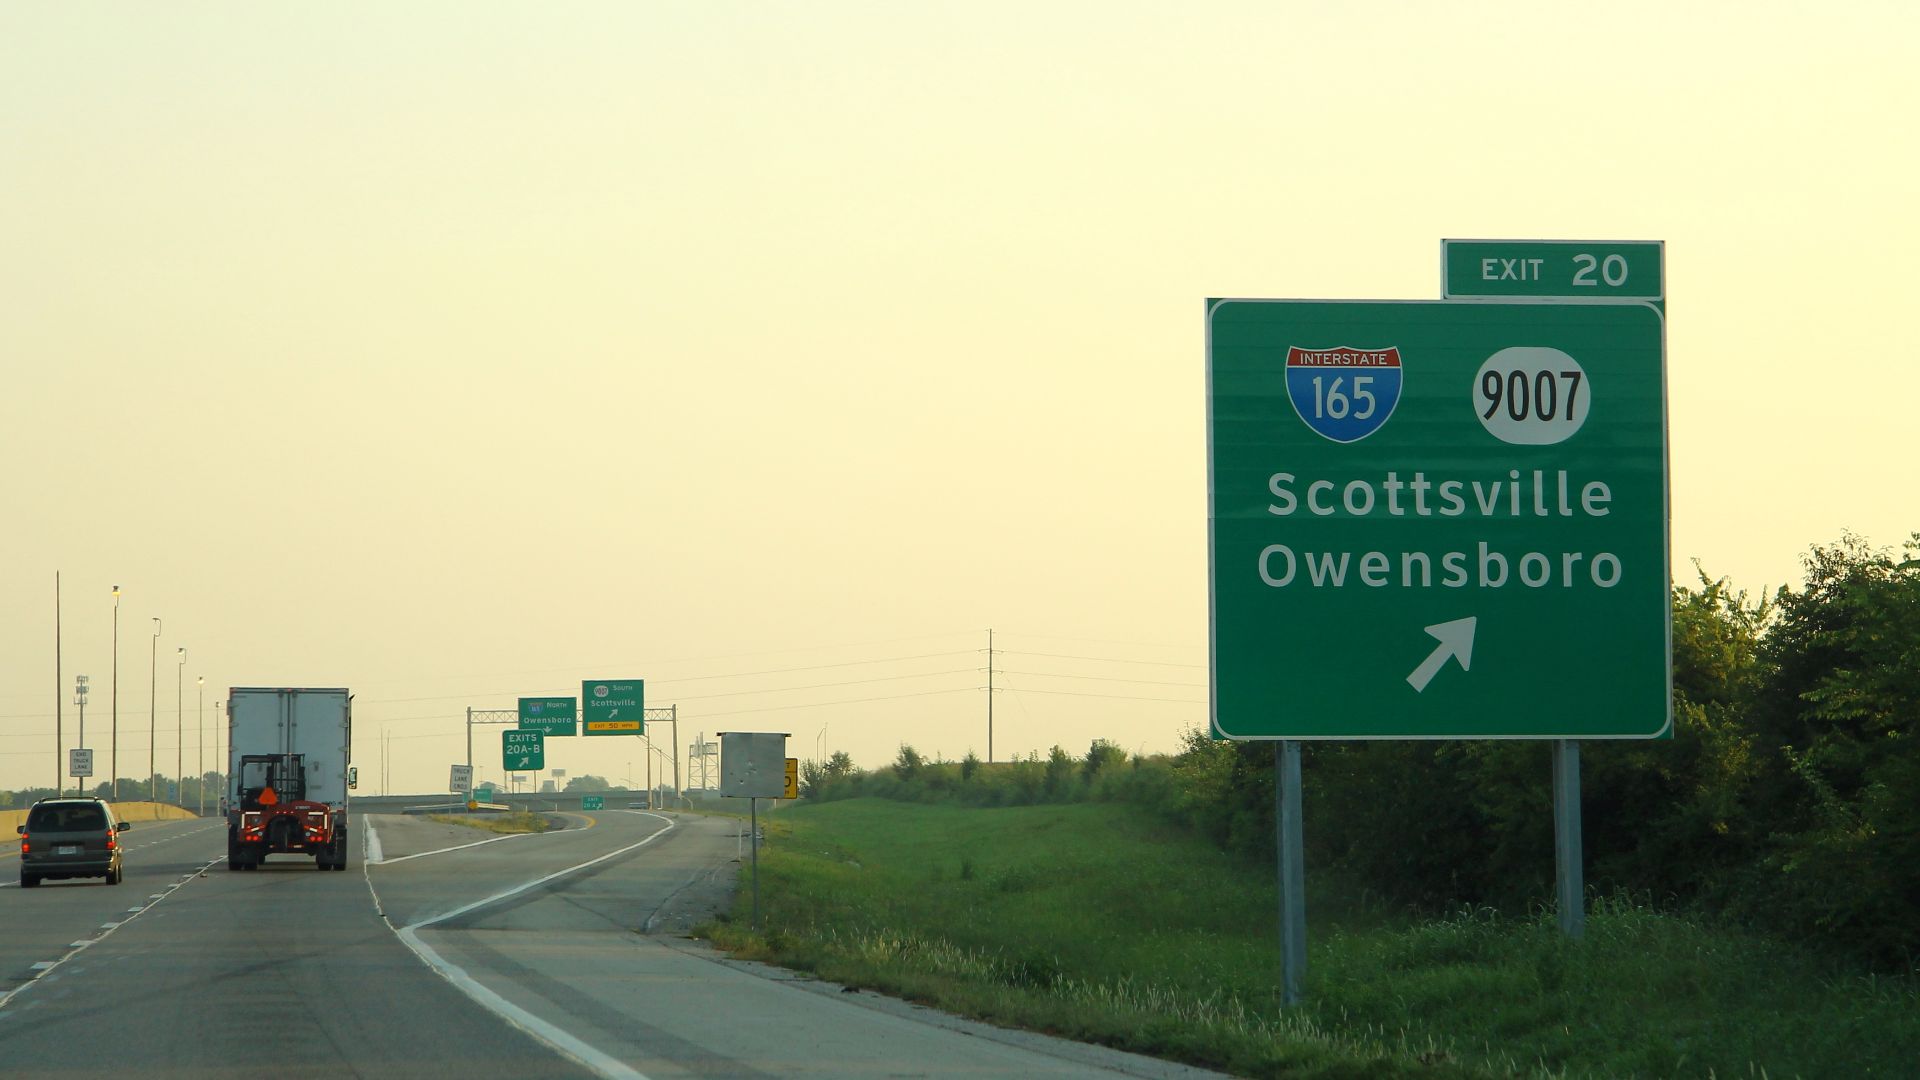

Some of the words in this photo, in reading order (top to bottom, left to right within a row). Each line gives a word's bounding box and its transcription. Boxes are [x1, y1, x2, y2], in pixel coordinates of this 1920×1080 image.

[1482, 258, 1544, 280] EXIT
[1572, 253, 1628, 287] 20
[1300, 353, 1387, 365] INTERSTATE
[1313, 376, 1376, 420] 165
[1481, 370, 1581, 422] 9007
[1268, 469, 1612, 517] Scottsville
[1258, 541, 1622, 588] Owensboro
[591, 699, 636, 707] Scottsville
[506, 744, 541, 755] 20A-B
[509, 733, 537, 743] EXITS
